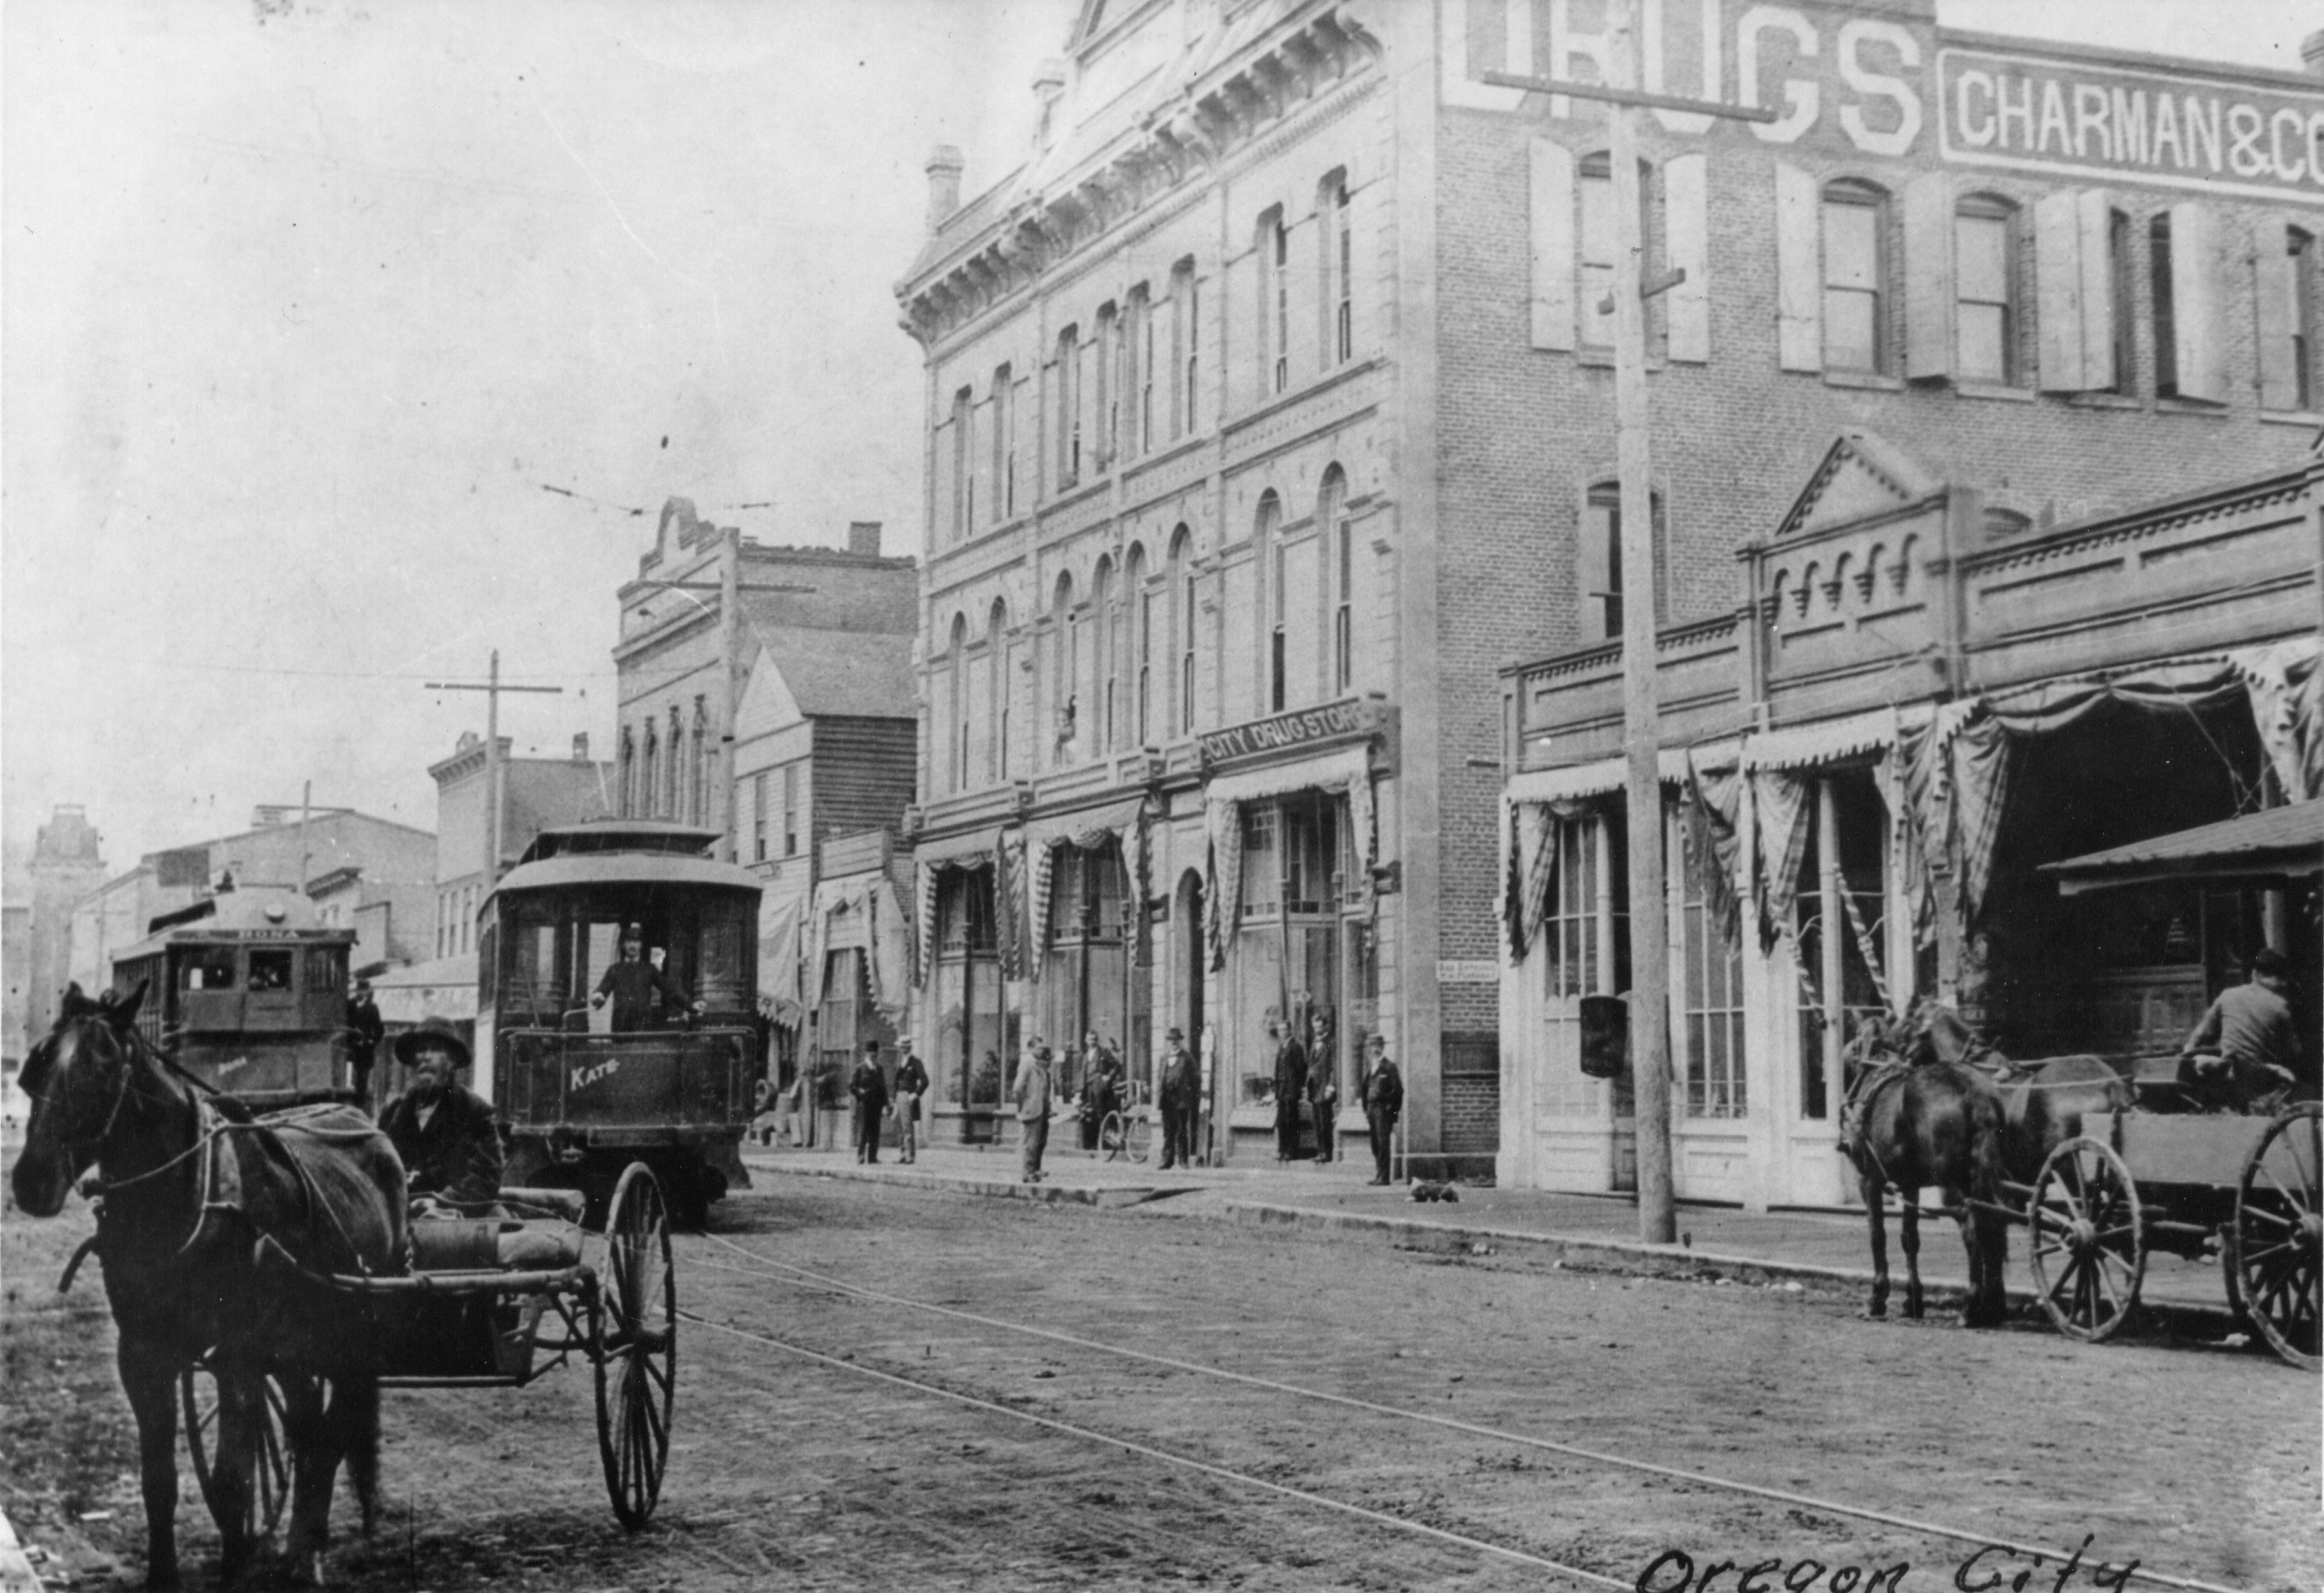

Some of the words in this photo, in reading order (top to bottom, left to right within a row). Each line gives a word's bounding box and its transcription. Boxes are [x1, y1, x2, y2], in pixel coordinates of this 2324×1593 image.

[1442, 0, 1922, 156] DRUGS
[1205, 728, 1249, 759] CITY
[1248, 716, 1305, 748] DRUG
[1302, 703, 1366, 737] STOR
